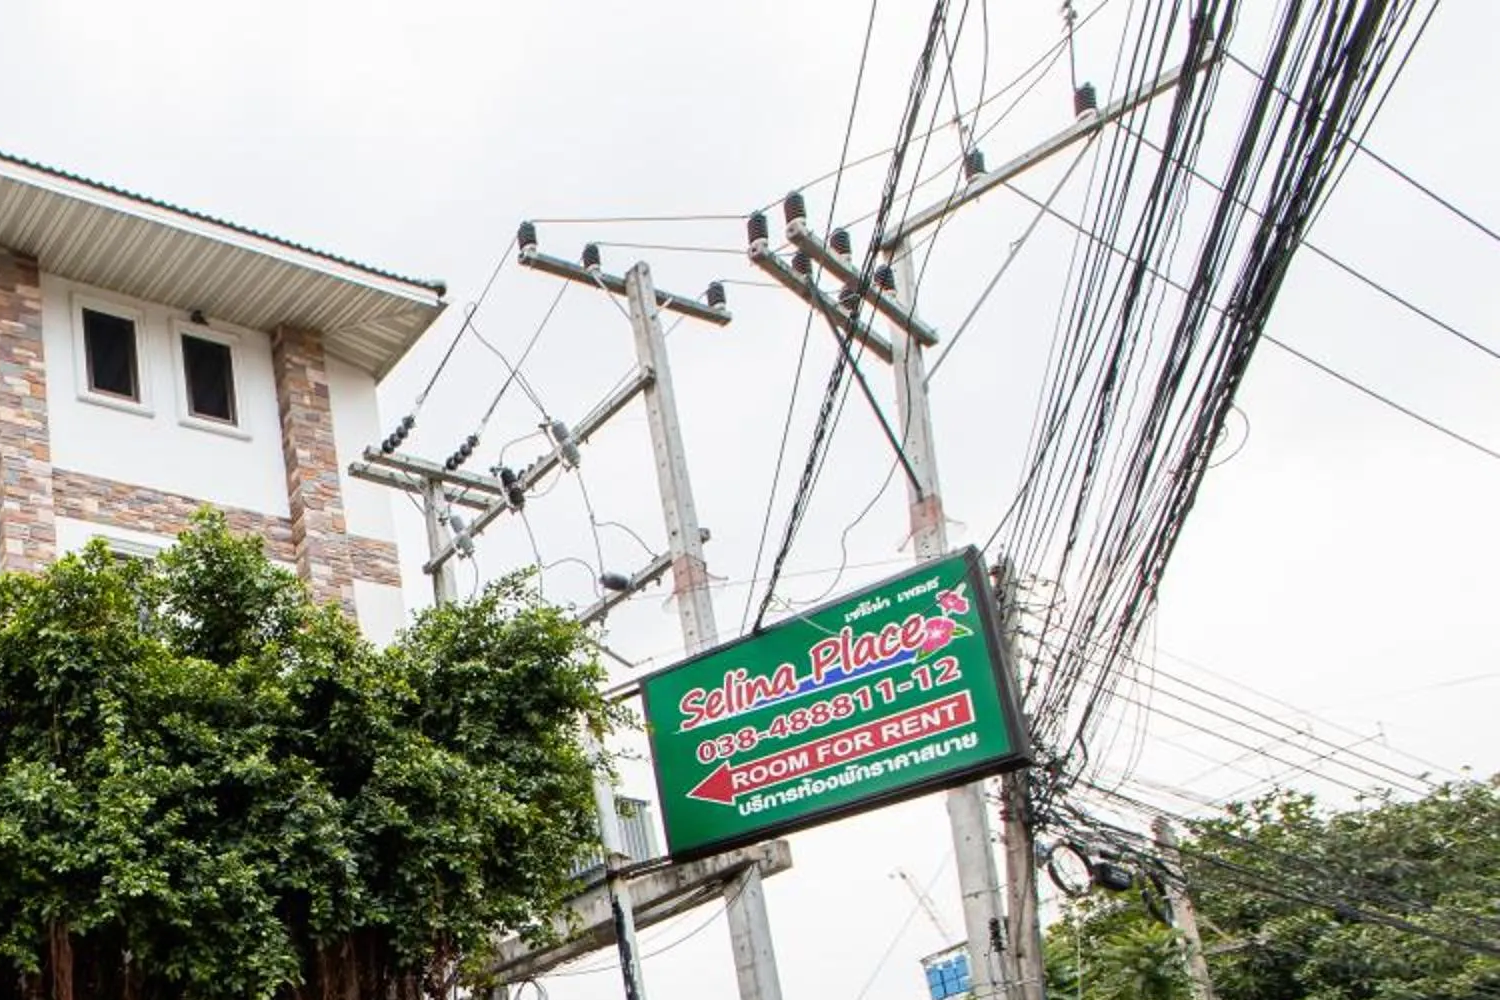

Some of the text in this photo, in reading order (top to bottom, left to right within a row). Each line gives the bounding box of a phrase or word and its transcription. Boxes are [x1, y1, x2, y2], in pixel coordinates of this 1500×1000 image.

[679, 612, 928, 732] Selina Place
[696, 655, 963, 764] 038-488811-12
[731, 701, 961, 790] ROOM FOR RENT
